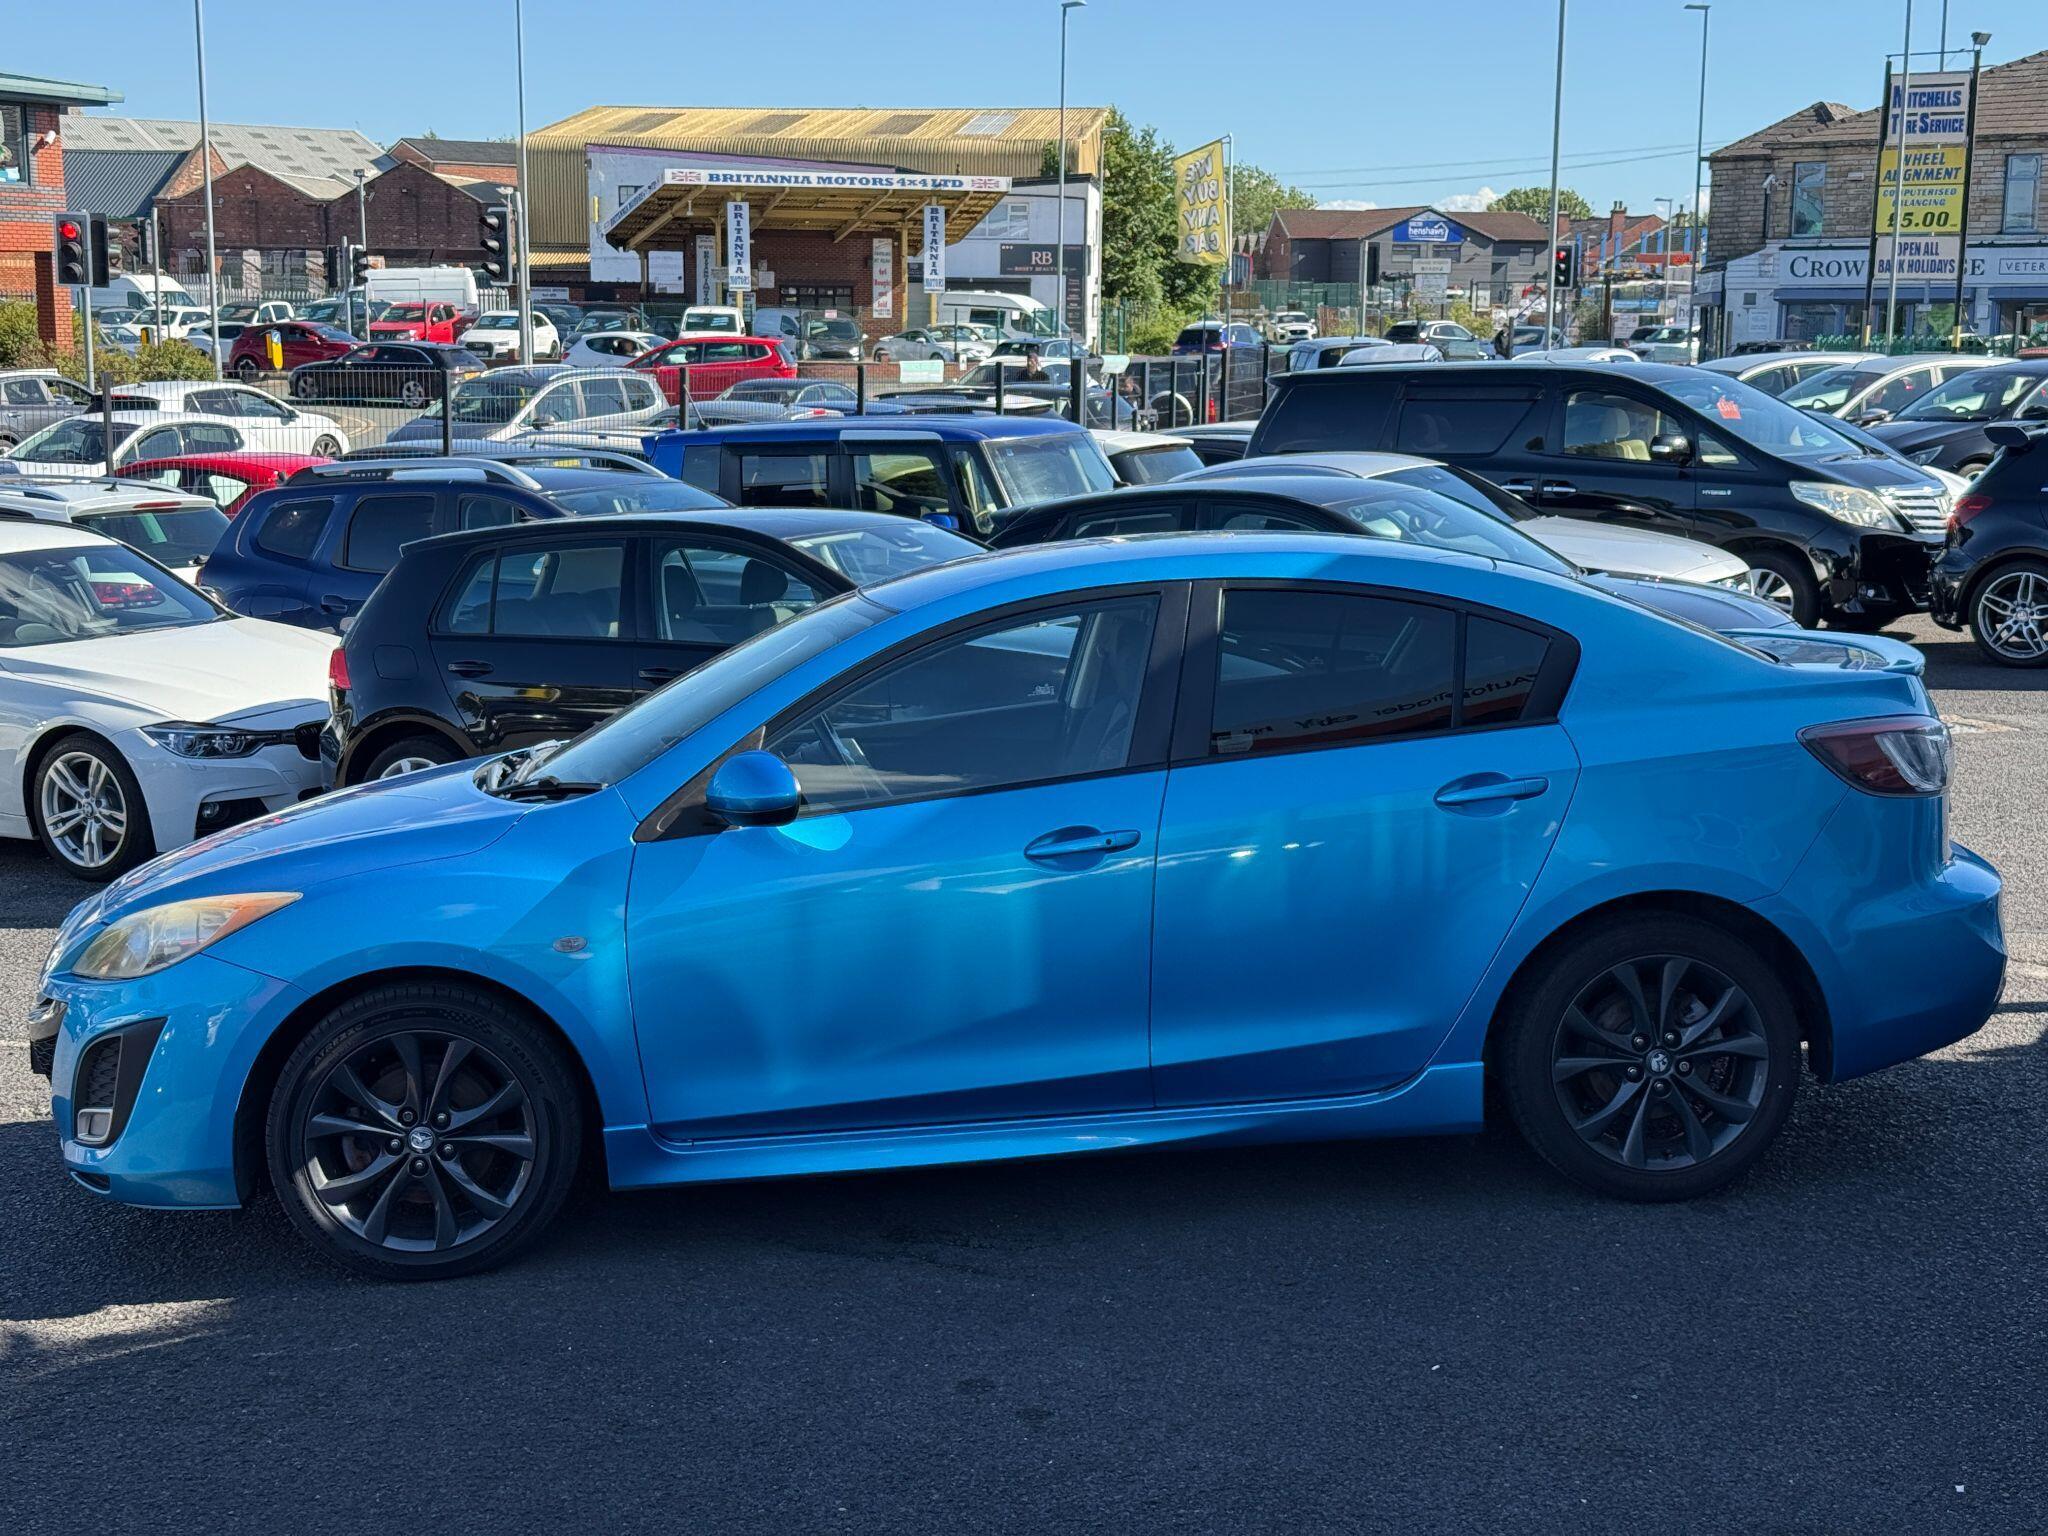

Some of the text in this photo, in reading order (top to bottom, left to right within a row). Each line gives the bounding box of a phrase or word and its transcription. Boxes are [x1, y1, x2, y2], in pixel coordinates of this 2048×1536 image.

[1891, 112, 1964, 134] TRE SERVICE
[707, 172, 964, 188] BRITANNIA MOTORS 4x4 LTD
[1882, 187, 1957, 197] COPUTERISED
[733, 204, 744, 274] BRITANNIA
[1408, 227, 1445, 236] henshaws
[929, 207, 940, 276] BRITANNIA
[1922, 241, 1940, 256] ALL
[1030, 250, 1053, 265] RB
[1789, 256, 1866, 278] CROW
[1877, 260, 1905, 274] BAK
[1907, 259, 1956, 274] HOLIDAYS
